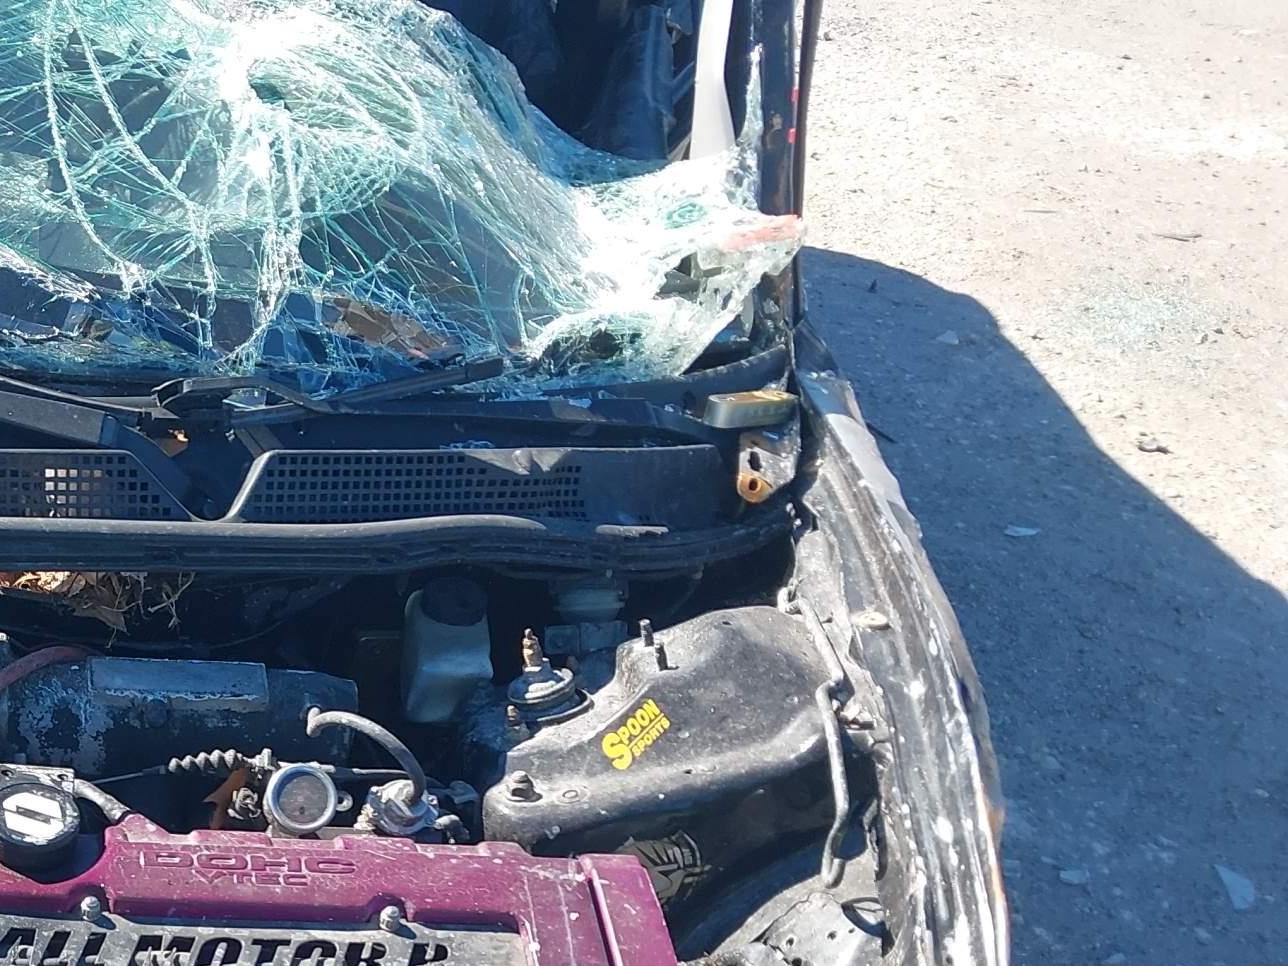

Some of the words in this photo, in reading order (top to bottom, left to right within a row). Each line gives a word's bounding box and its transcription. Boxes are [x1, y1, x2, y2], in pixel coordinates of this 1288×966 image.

[601, 698, 661, 771] SPOON
[631, 716, 671, 758] SPORTS
[139, 851, 356, 875] DOHC
[193, 869, 309, 887] VTEC
